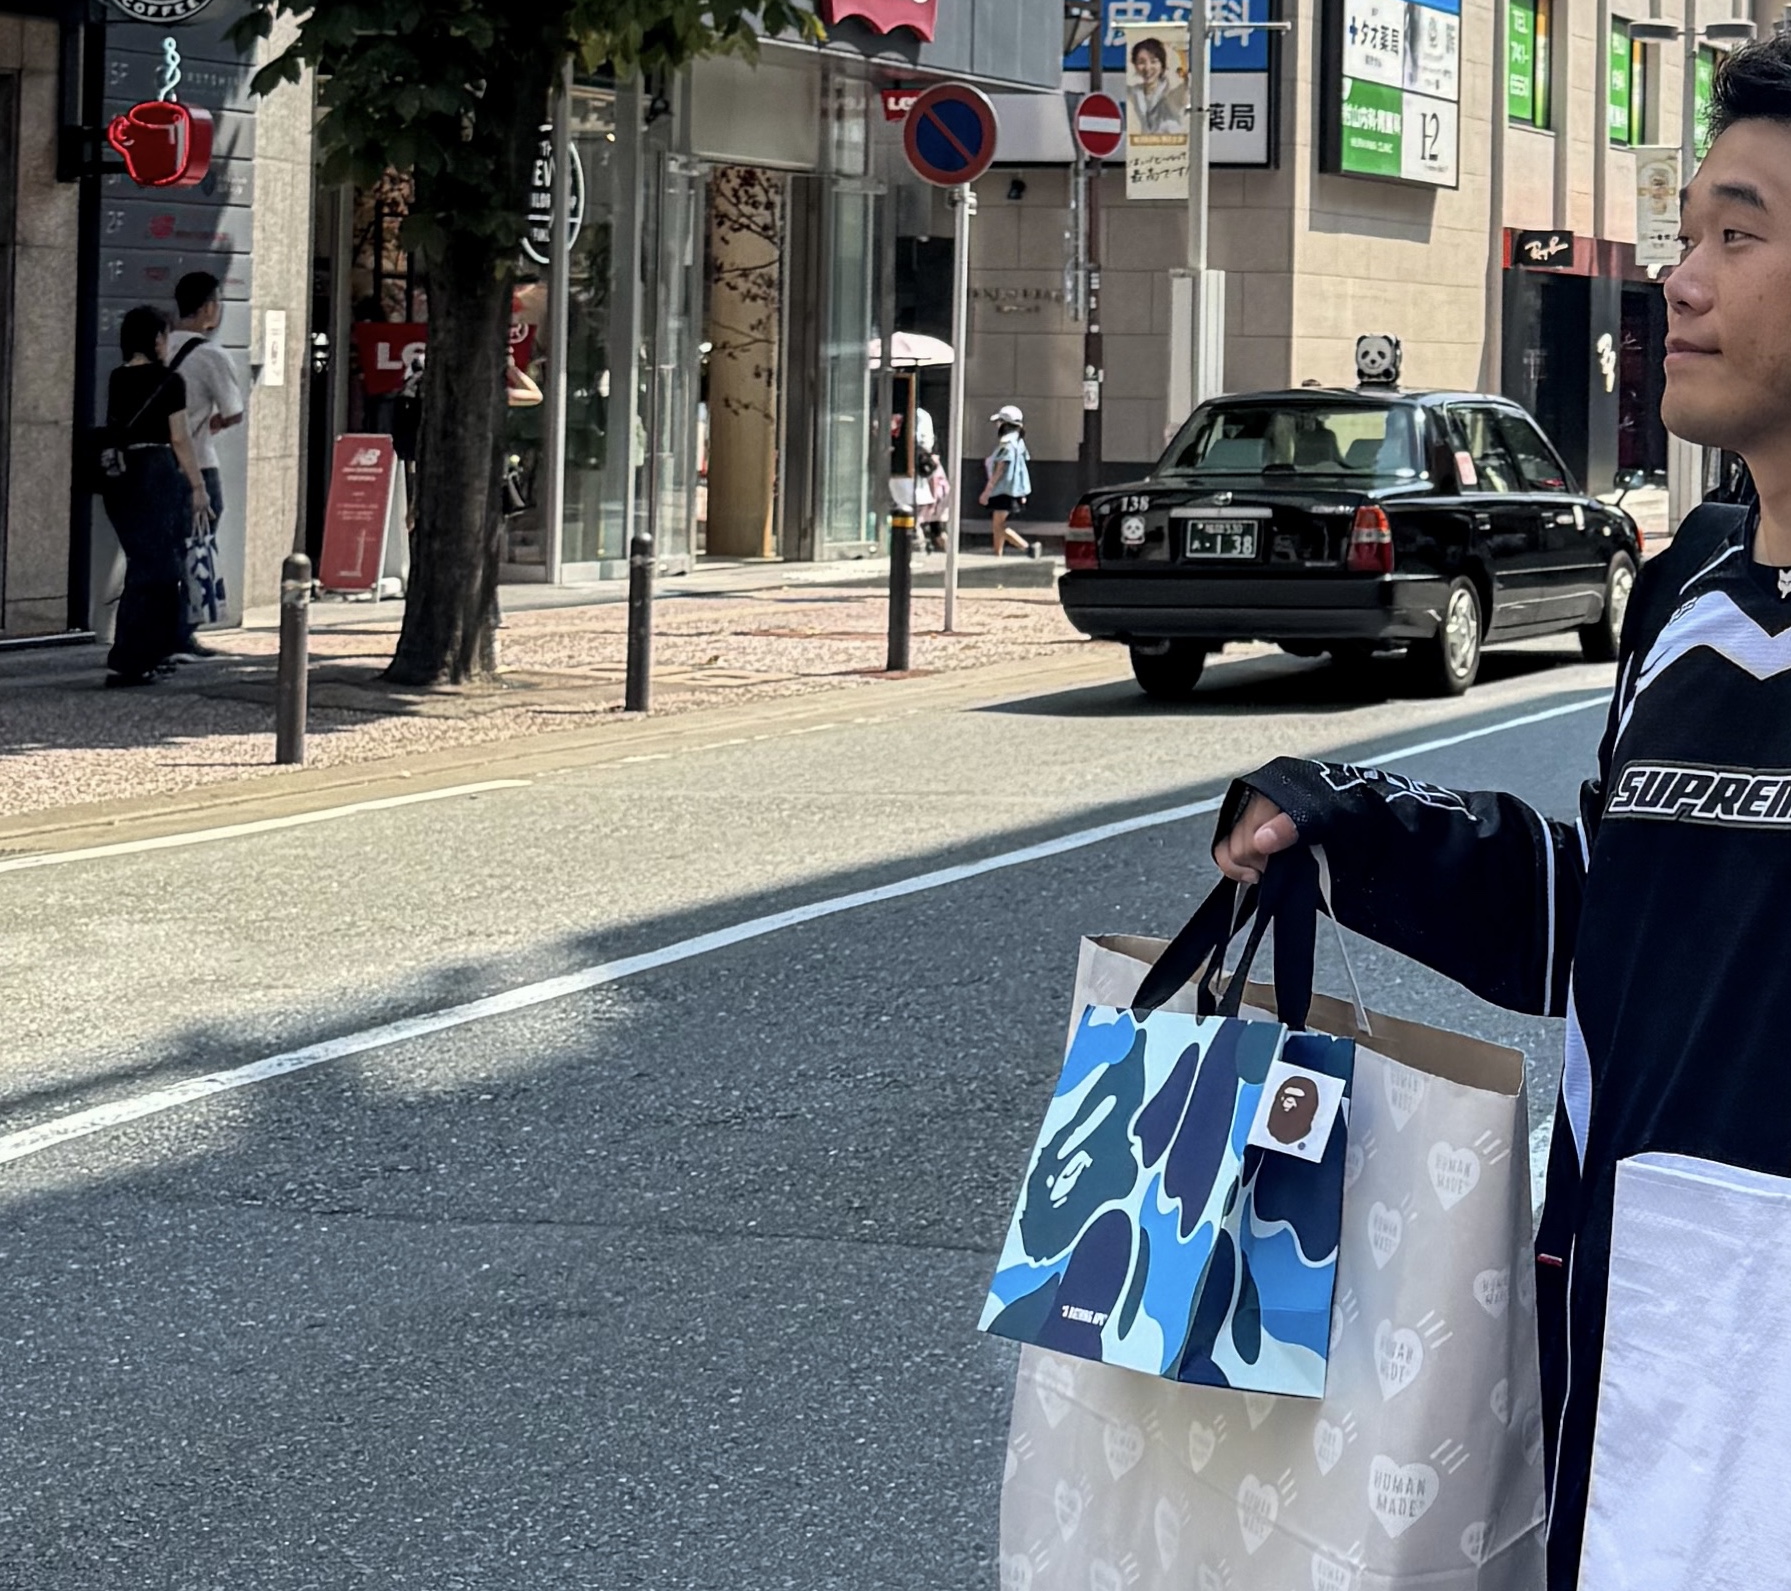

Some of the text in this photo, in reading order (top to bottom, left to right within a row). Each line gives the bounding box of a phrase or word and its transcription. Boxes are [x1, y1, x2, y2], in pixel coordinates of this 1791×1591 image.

[1120, 495, 1150, 513] 138
[1373, 1470, 1427, 1496] HUMAN
[1375, 1495, 1419, 1518] MADE
